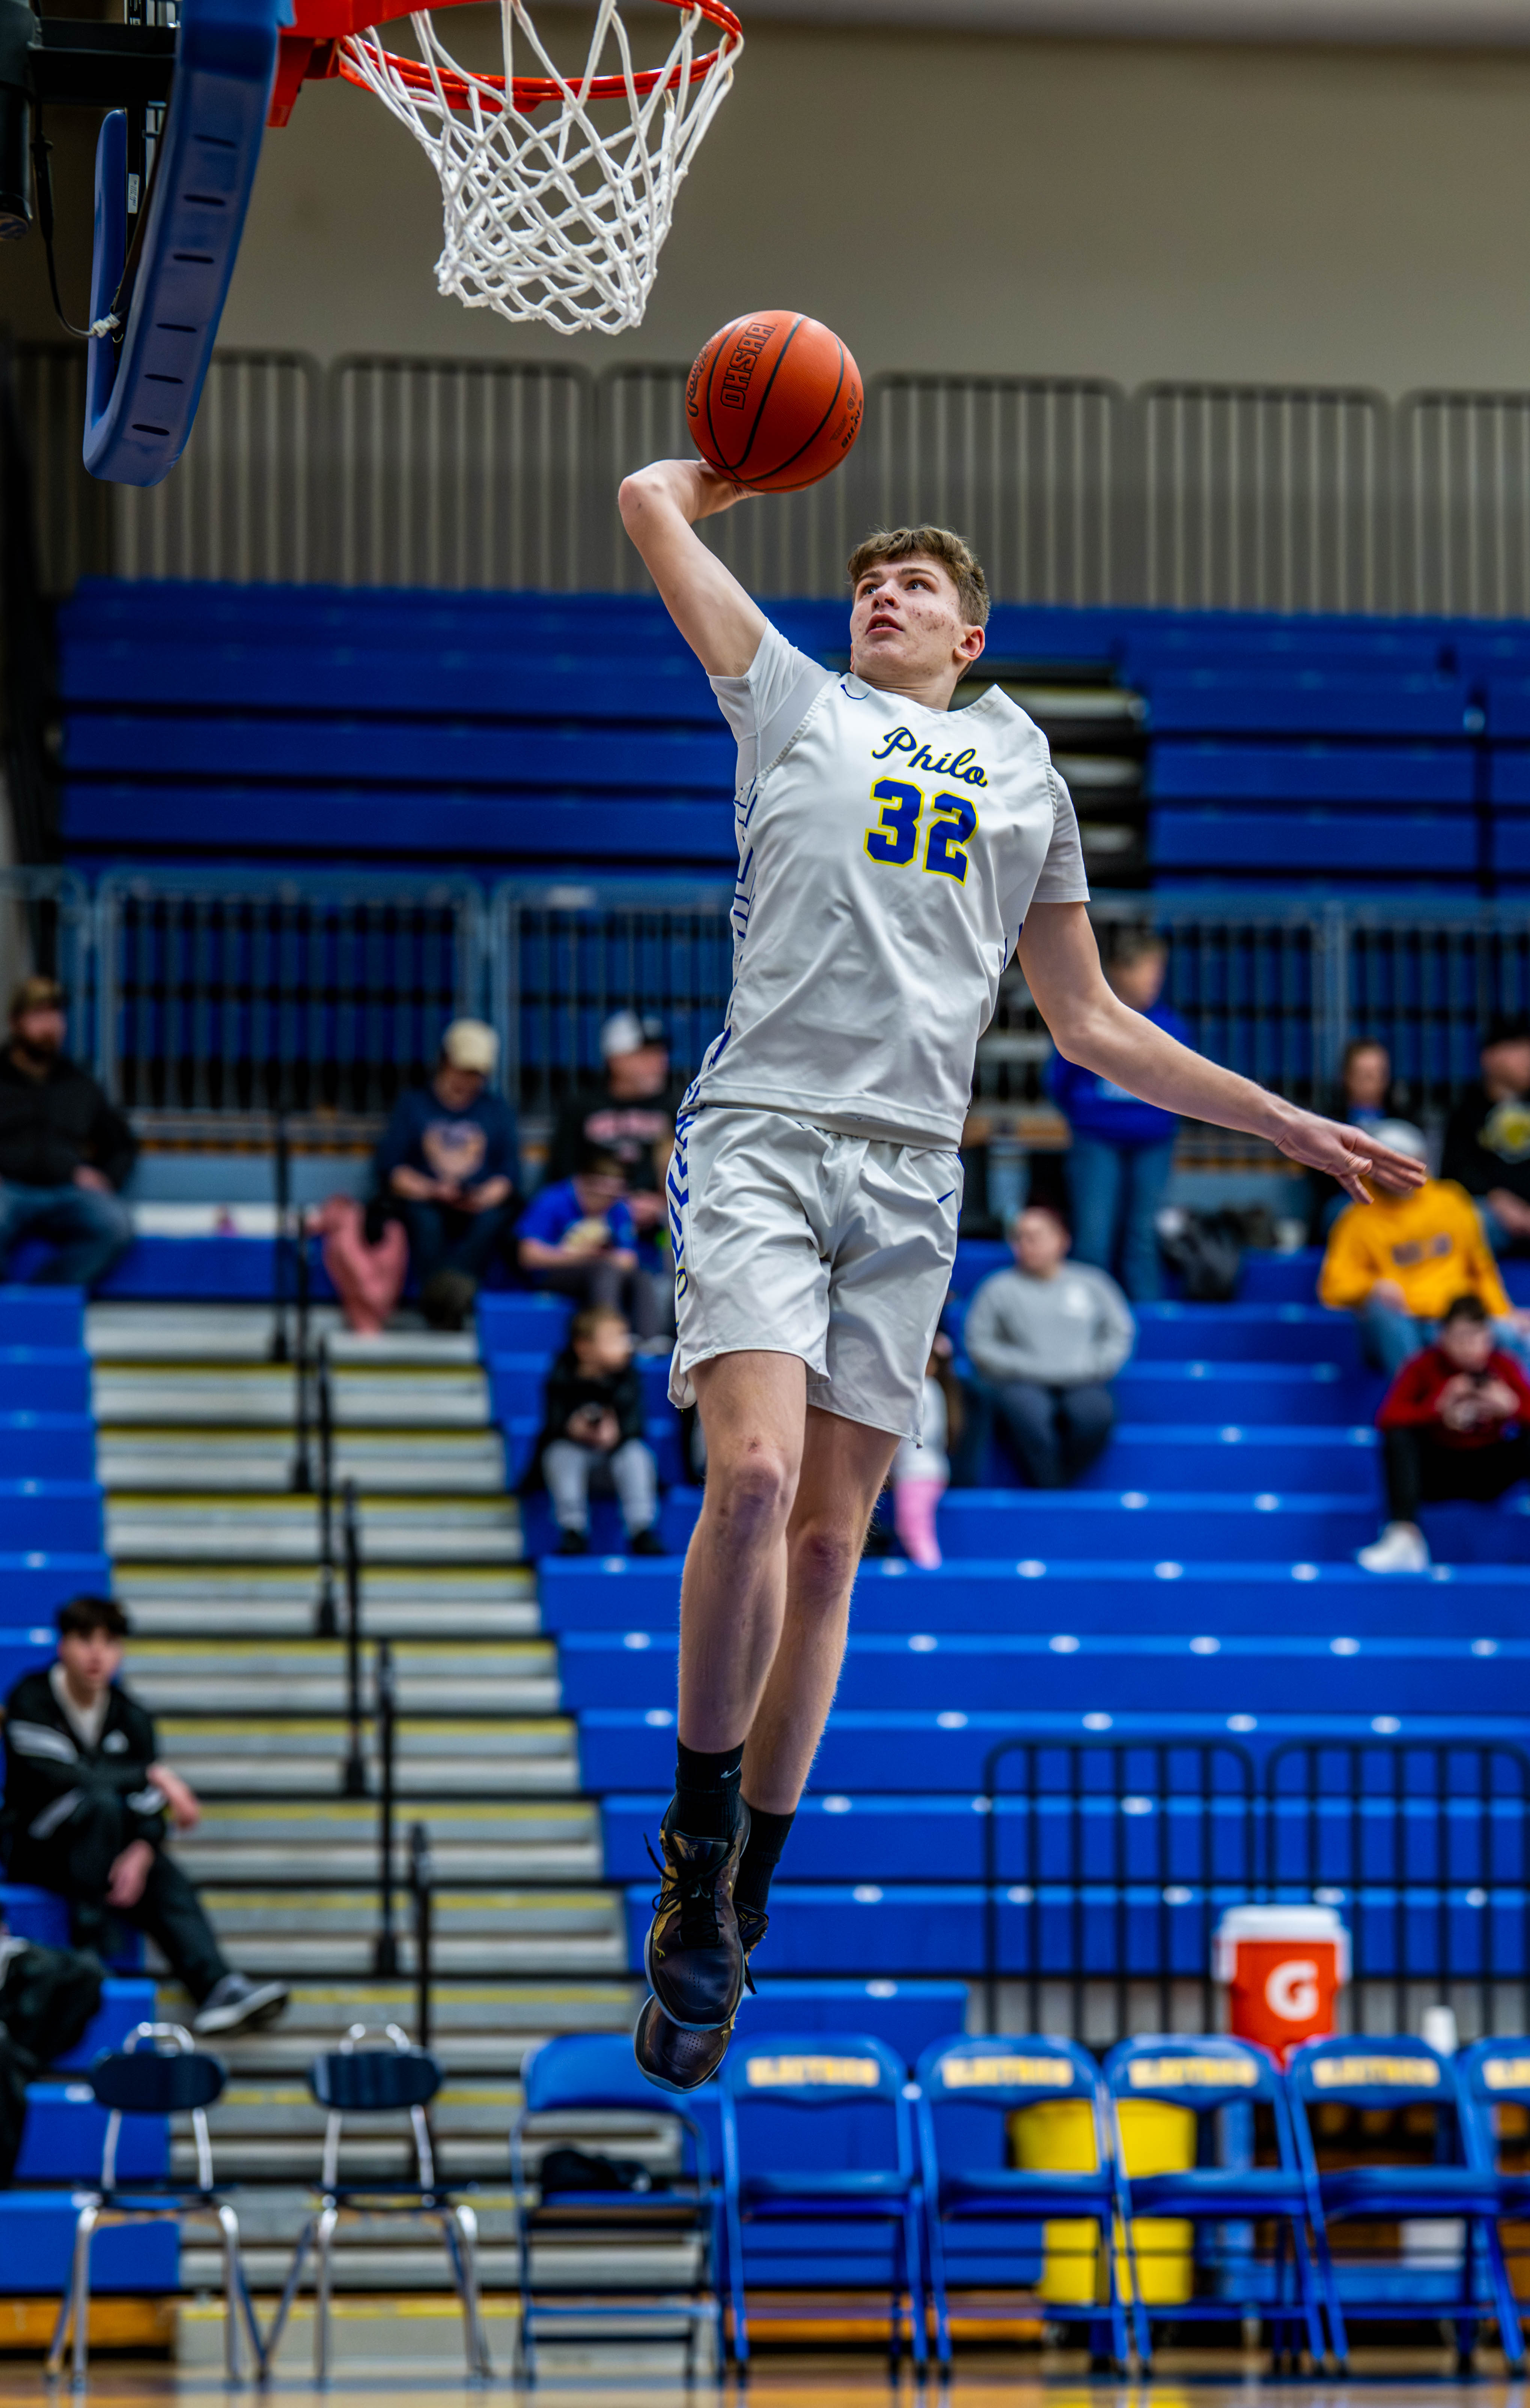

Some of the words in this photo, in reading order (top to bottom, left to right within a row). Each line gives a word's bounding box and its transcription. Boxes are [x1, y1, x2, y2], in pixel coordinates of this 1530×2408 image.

[720, 323, 776, 410] OHSAA
[871, 726, 988, 788] Philo
[863, 776, 979, 887] 32
[1265, 1959, 1319, 2022] G
